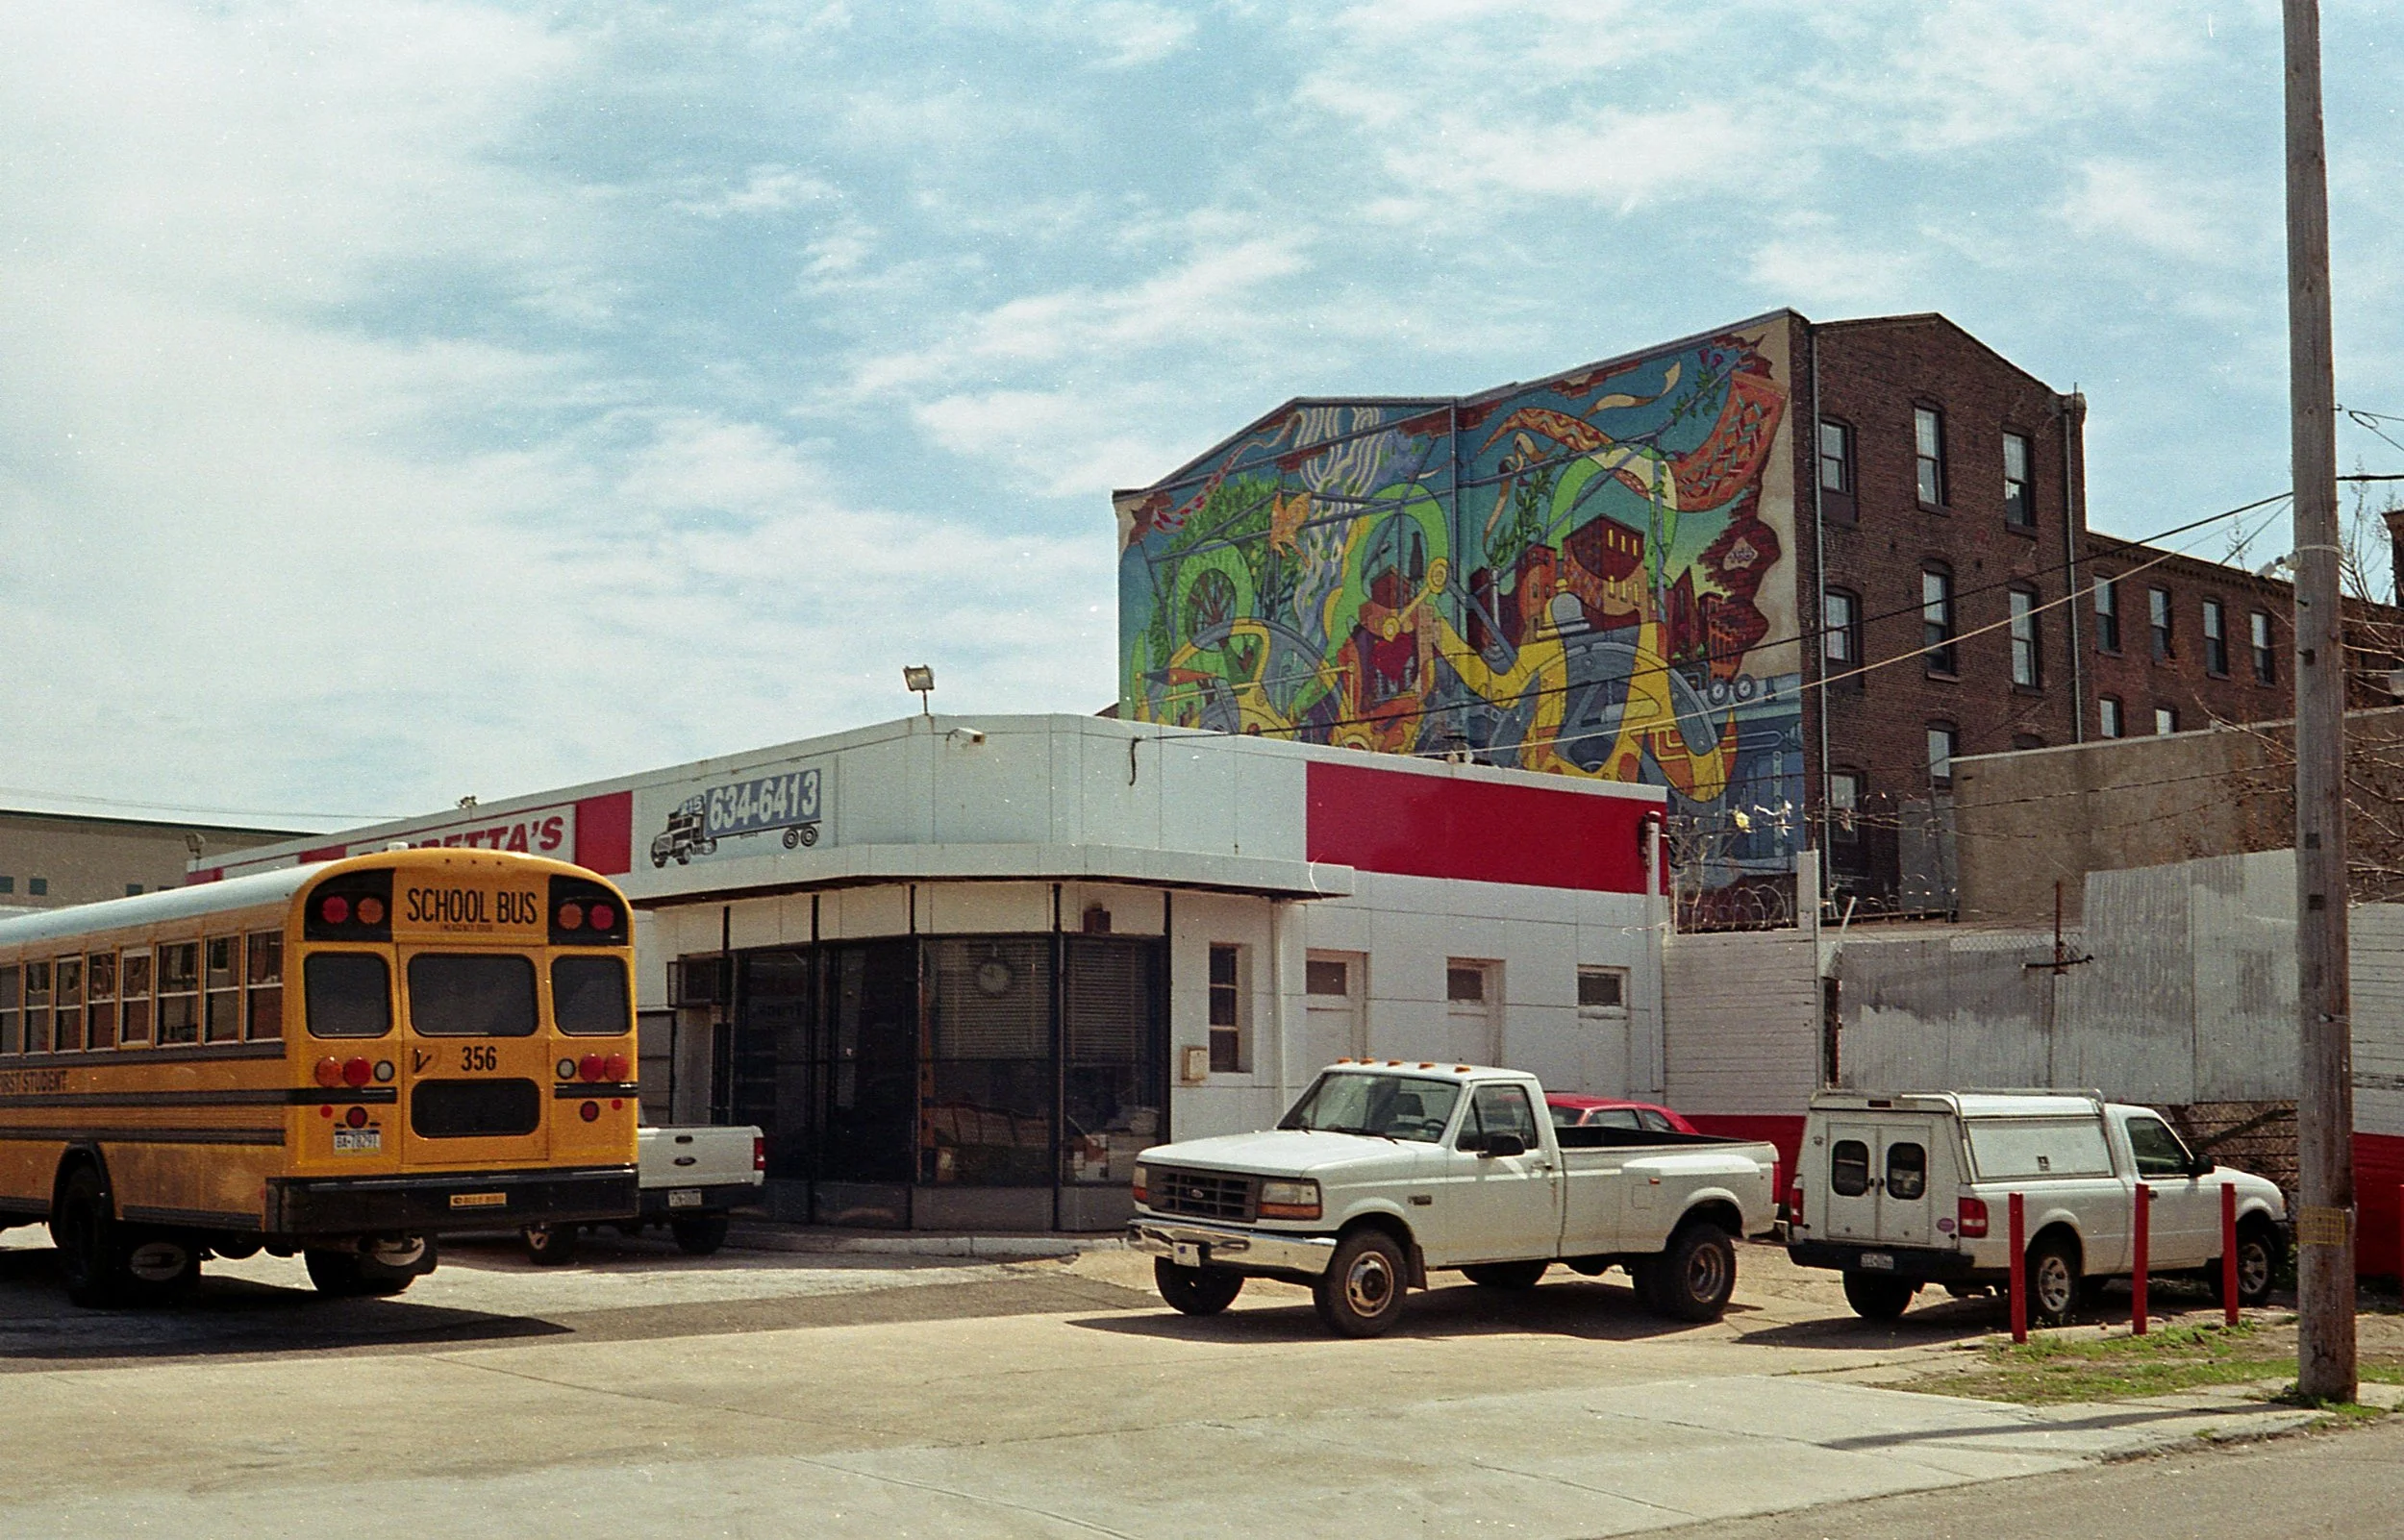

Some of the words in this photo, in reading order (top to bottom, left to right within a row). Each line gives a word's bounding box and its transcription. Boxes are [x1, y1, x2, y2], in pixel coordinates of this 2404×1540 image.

[709, 770, 818, 832] 634-6413
[407, 887, 491, 923] SCHOOL
[496, 890, 538, 924] BUS
[462, 1045, 497, 1072] 356
